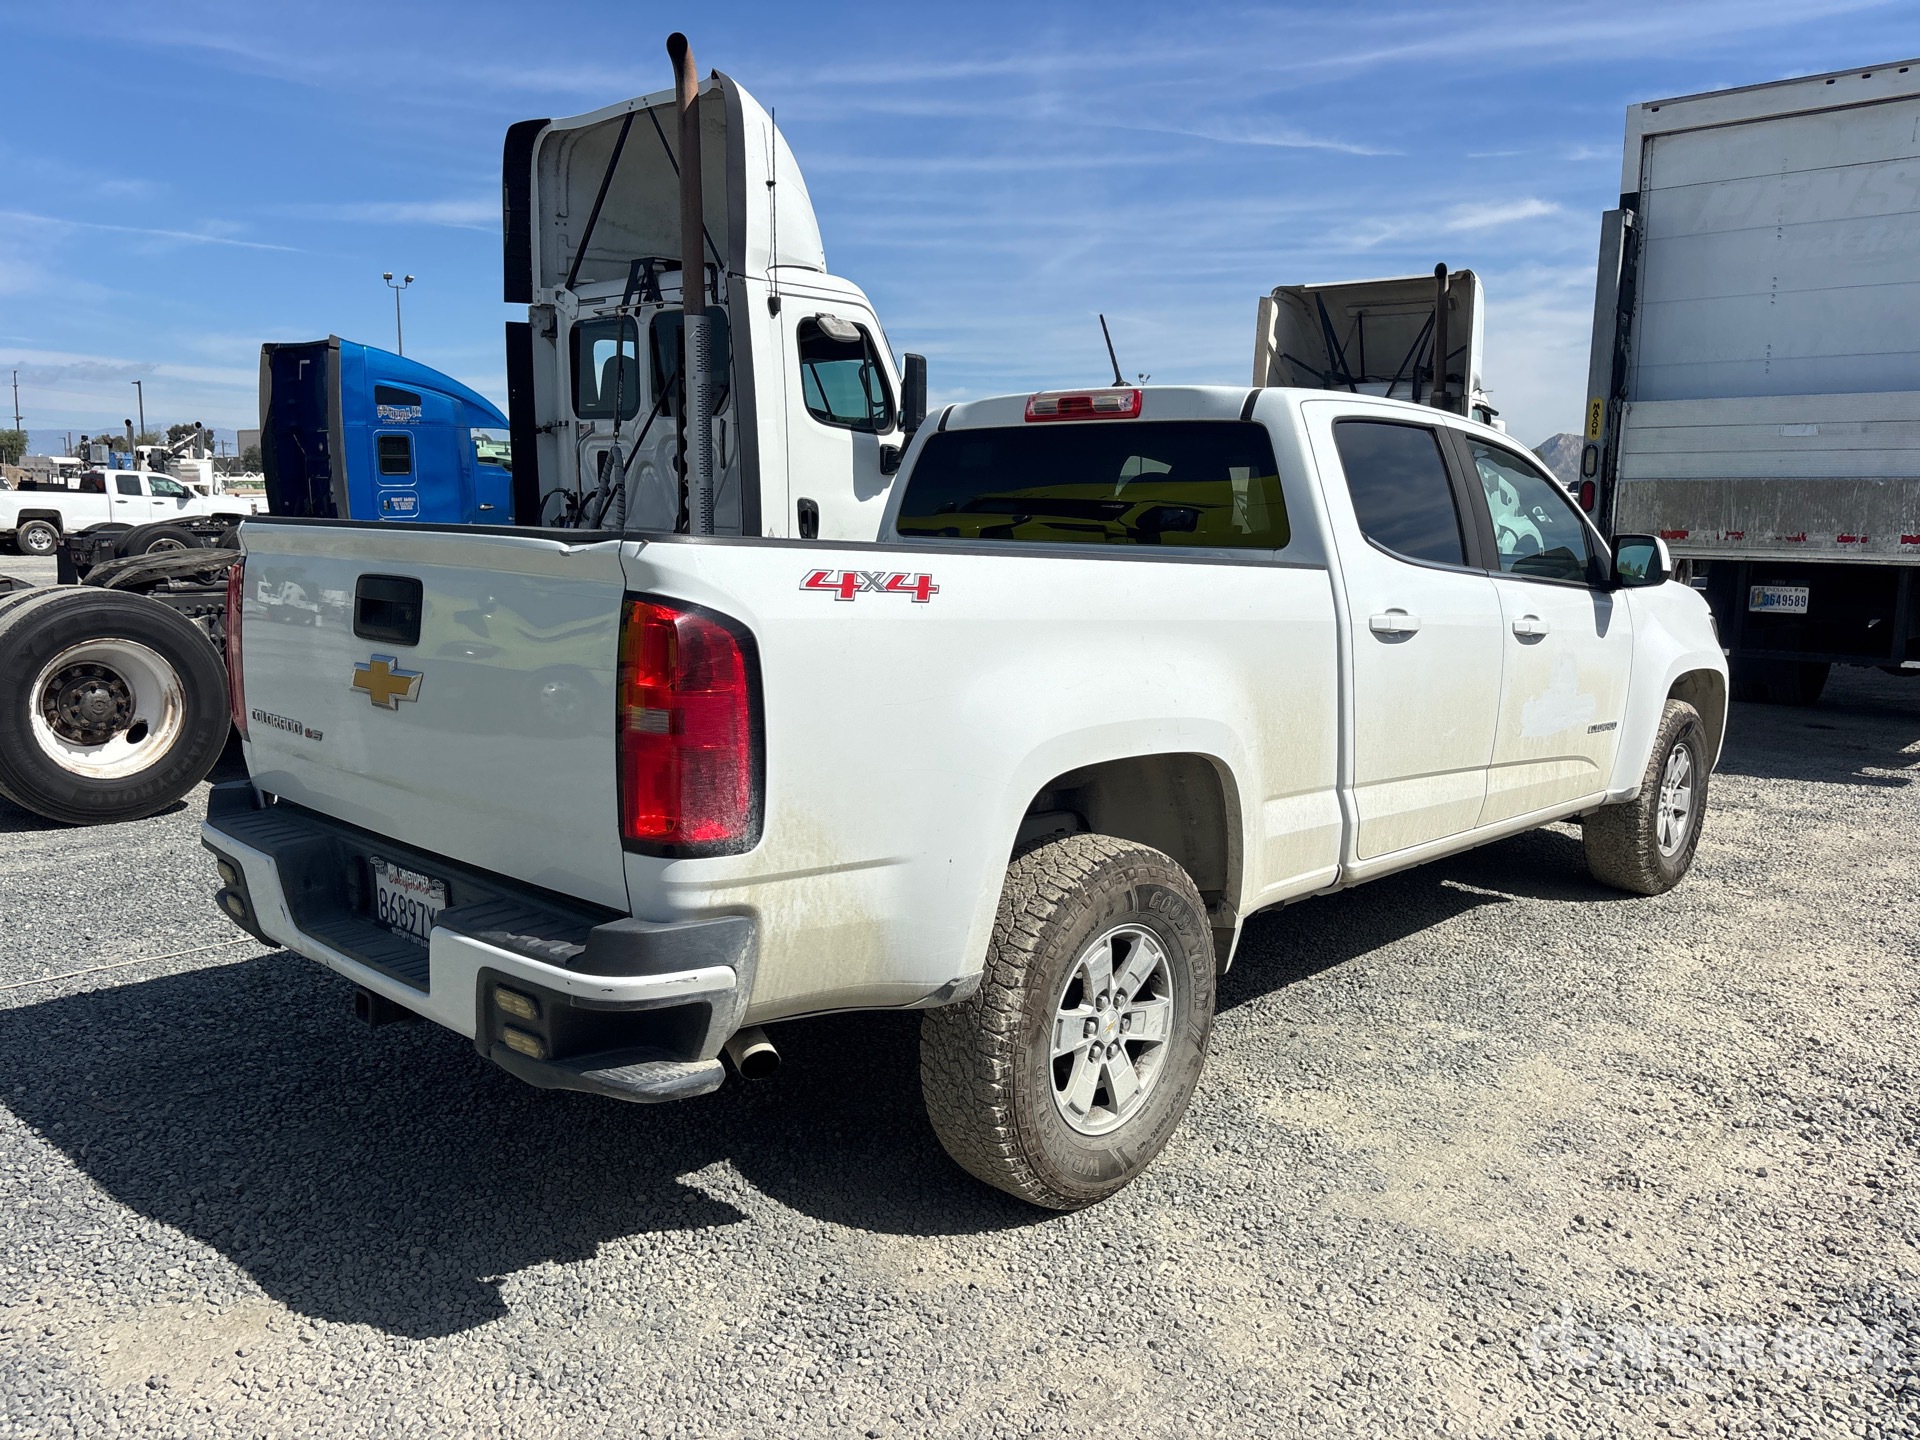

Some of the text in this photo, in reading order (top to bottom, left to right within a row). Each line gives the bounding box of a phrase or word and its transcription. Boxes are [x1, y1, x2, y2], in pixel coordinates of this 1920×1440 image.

[1592, 402, 1600, 436] MAXON
[1763, 594, 1807, 608] 3649589
[252, 708, 303, 735] COLORADO
[1148, 890, 1211, 1012] GOODYEAR
